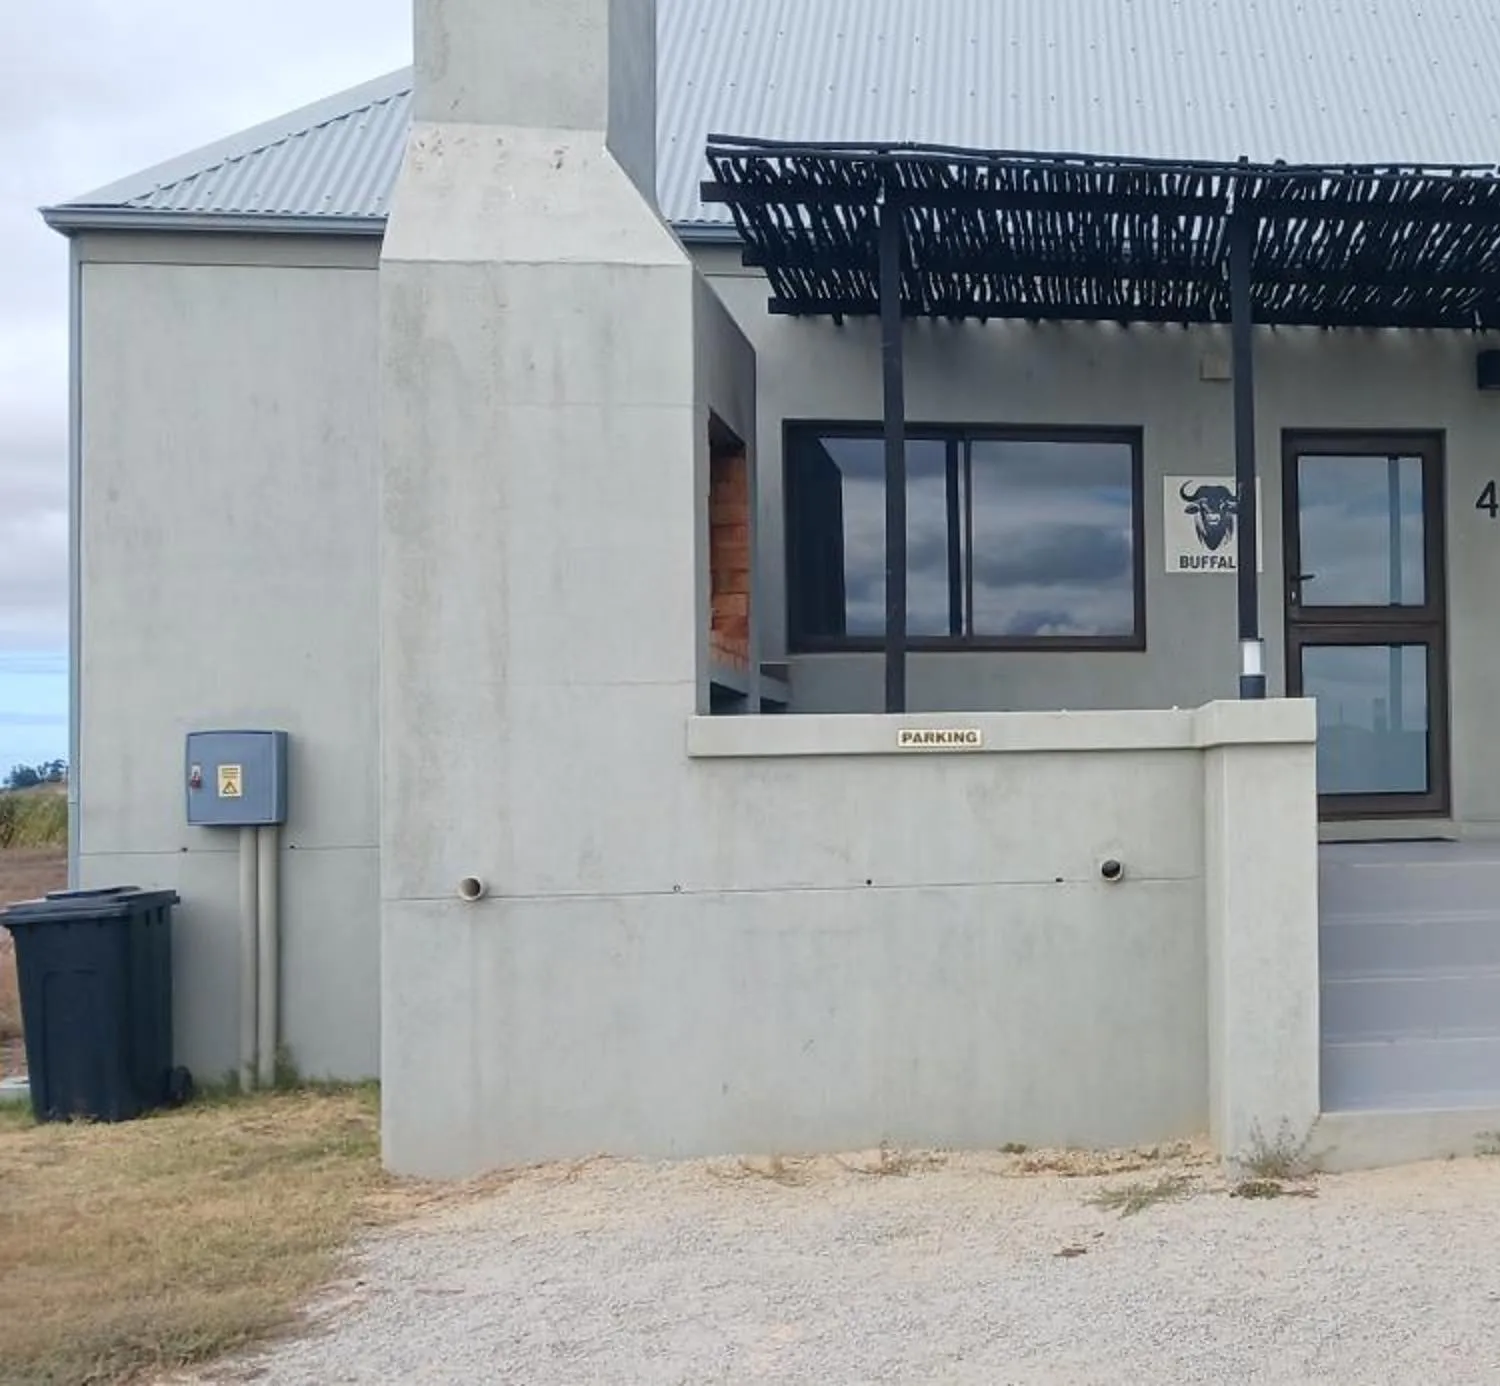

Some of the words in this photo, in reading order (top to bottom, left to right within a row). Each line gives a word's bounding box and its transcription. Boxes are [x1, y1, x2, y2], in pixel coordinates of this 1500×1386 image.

[1475, 480, 1499, 519] 4
[1179, 555, 1237, 569] BUFFAL
[902, 731, 977, 743] PARKING
